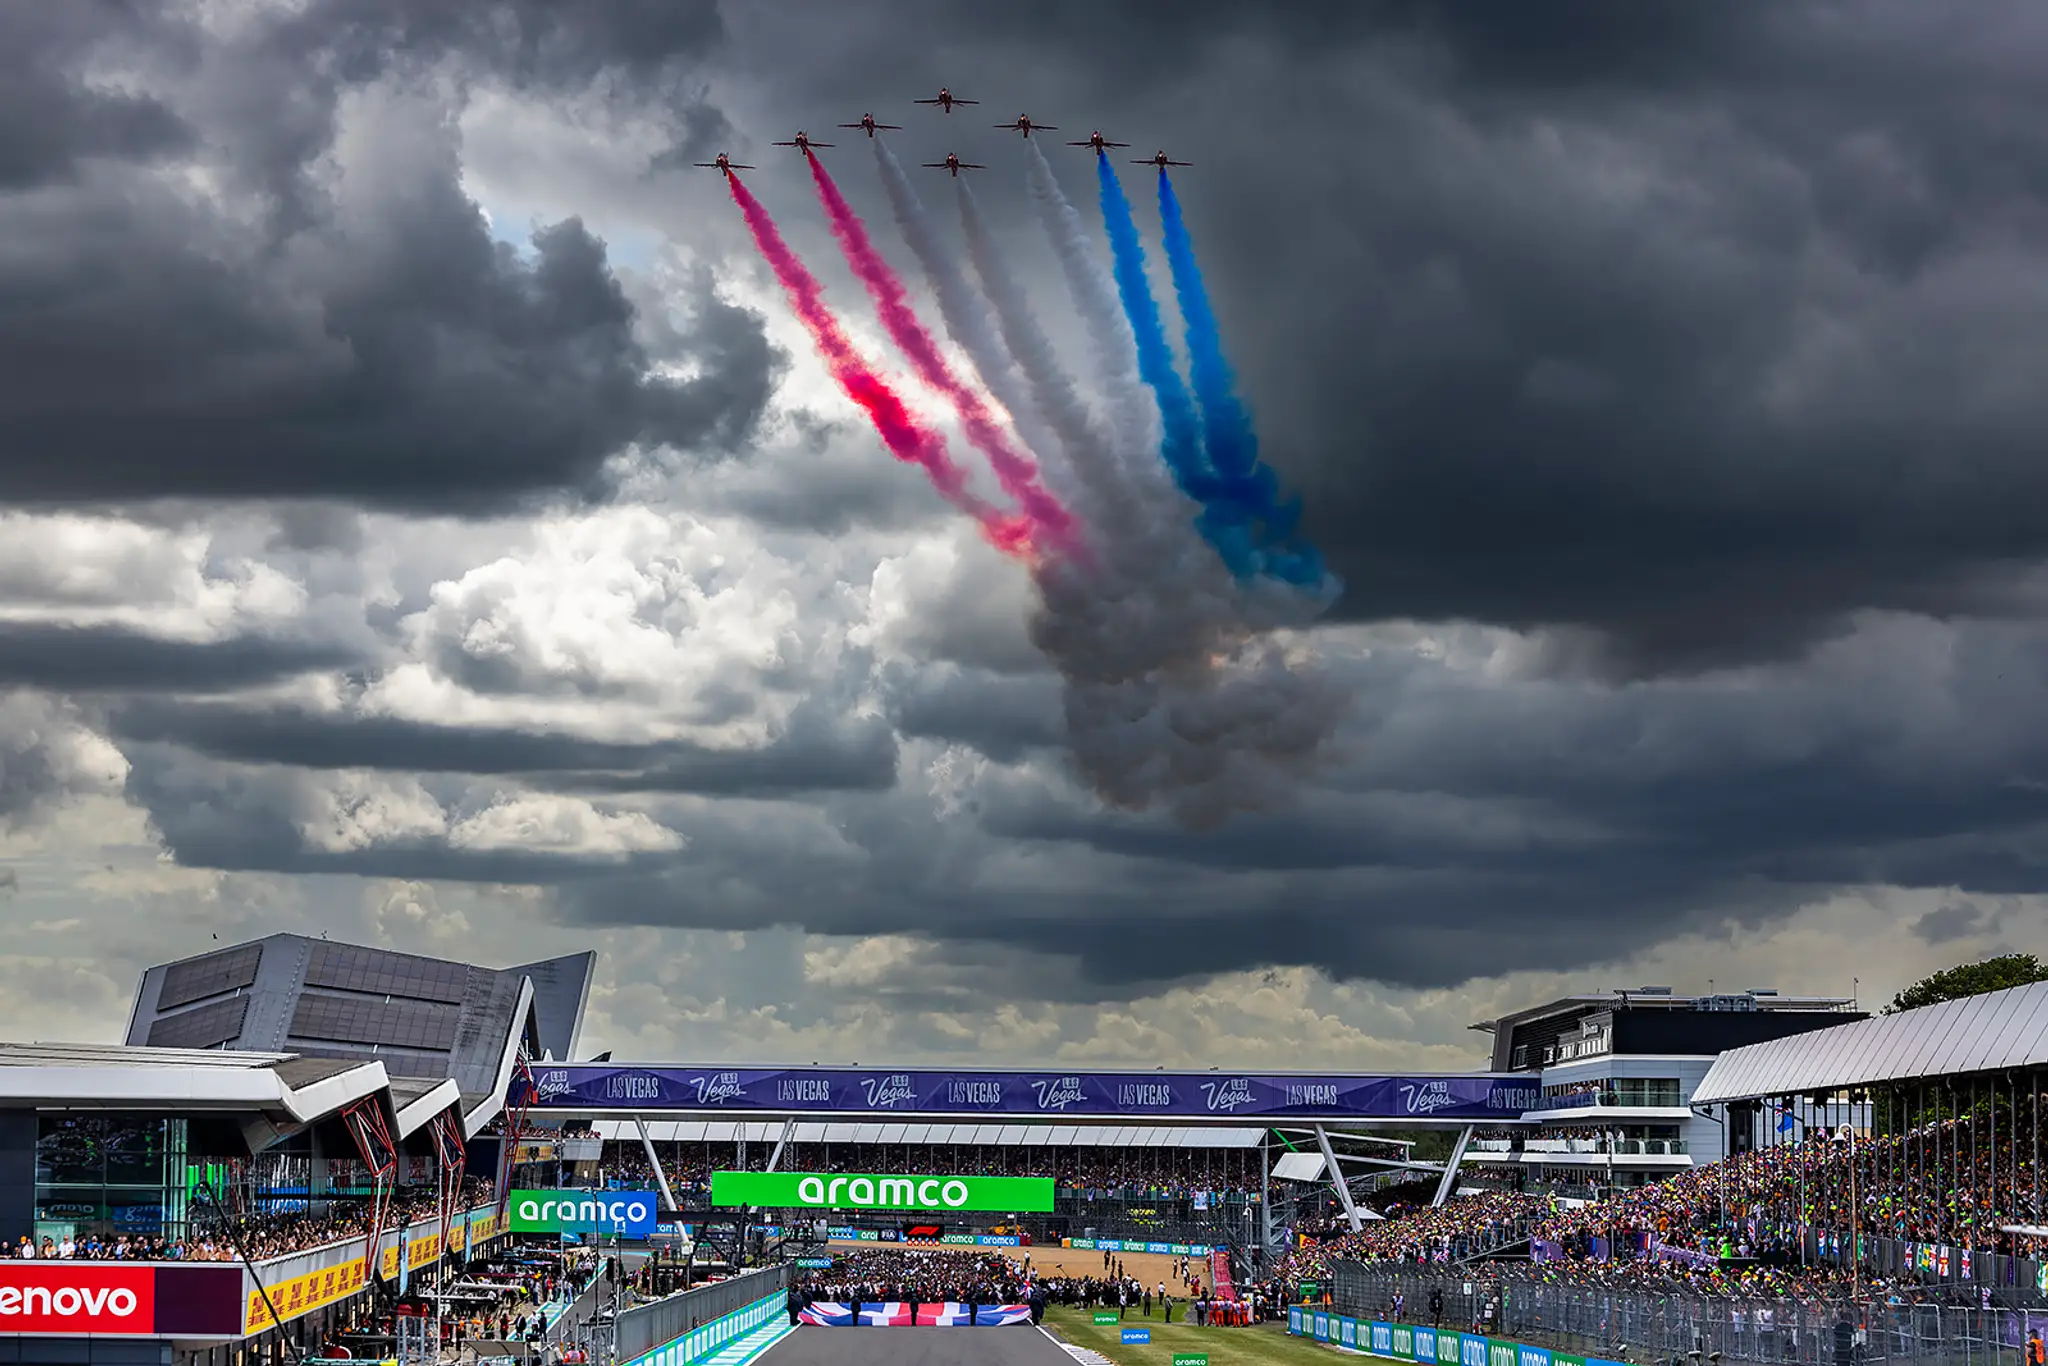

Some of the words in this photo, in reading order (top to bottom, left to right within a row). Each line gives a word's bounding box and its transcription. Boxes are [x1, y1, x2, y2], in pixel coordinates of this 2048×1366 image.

[607, 1078, 623, 1098] LAS
[624, 1077, 658, 1098] VEGAS
[690, 1075, 747, 1104] Vegas
[778, 1080, 794, 1100] LAS
[795, 1080, 829, 1100] VEGAS
[861, 1077, 917, 1107] Vegas
[949, 1082, 965, 1103] LAS
[966, 1083, 1000, 1103] VEGAS
[1031, 1079, 1087, 1110] Vegas
[1119, 1084, 1135, 1105] LAS
[1136, 1084, 1170, 1105] VEGAS
[1200, 1081, 1256, 1111] Vegas
[1286, 1085, 1302, 1105] LAS
[1303, 1085, 1337, 1105] VEGAS
[1400, 1084, 1456, 1113] Vegas
[798, 1177, 968, 1207] aramco
[519, 1200, 647, 1223] aramco
[941, 1235, 974, 1244] aramco
[982, 1236, 1015, 1245] aramco
[0, 1287, 137, 1316] enovo
